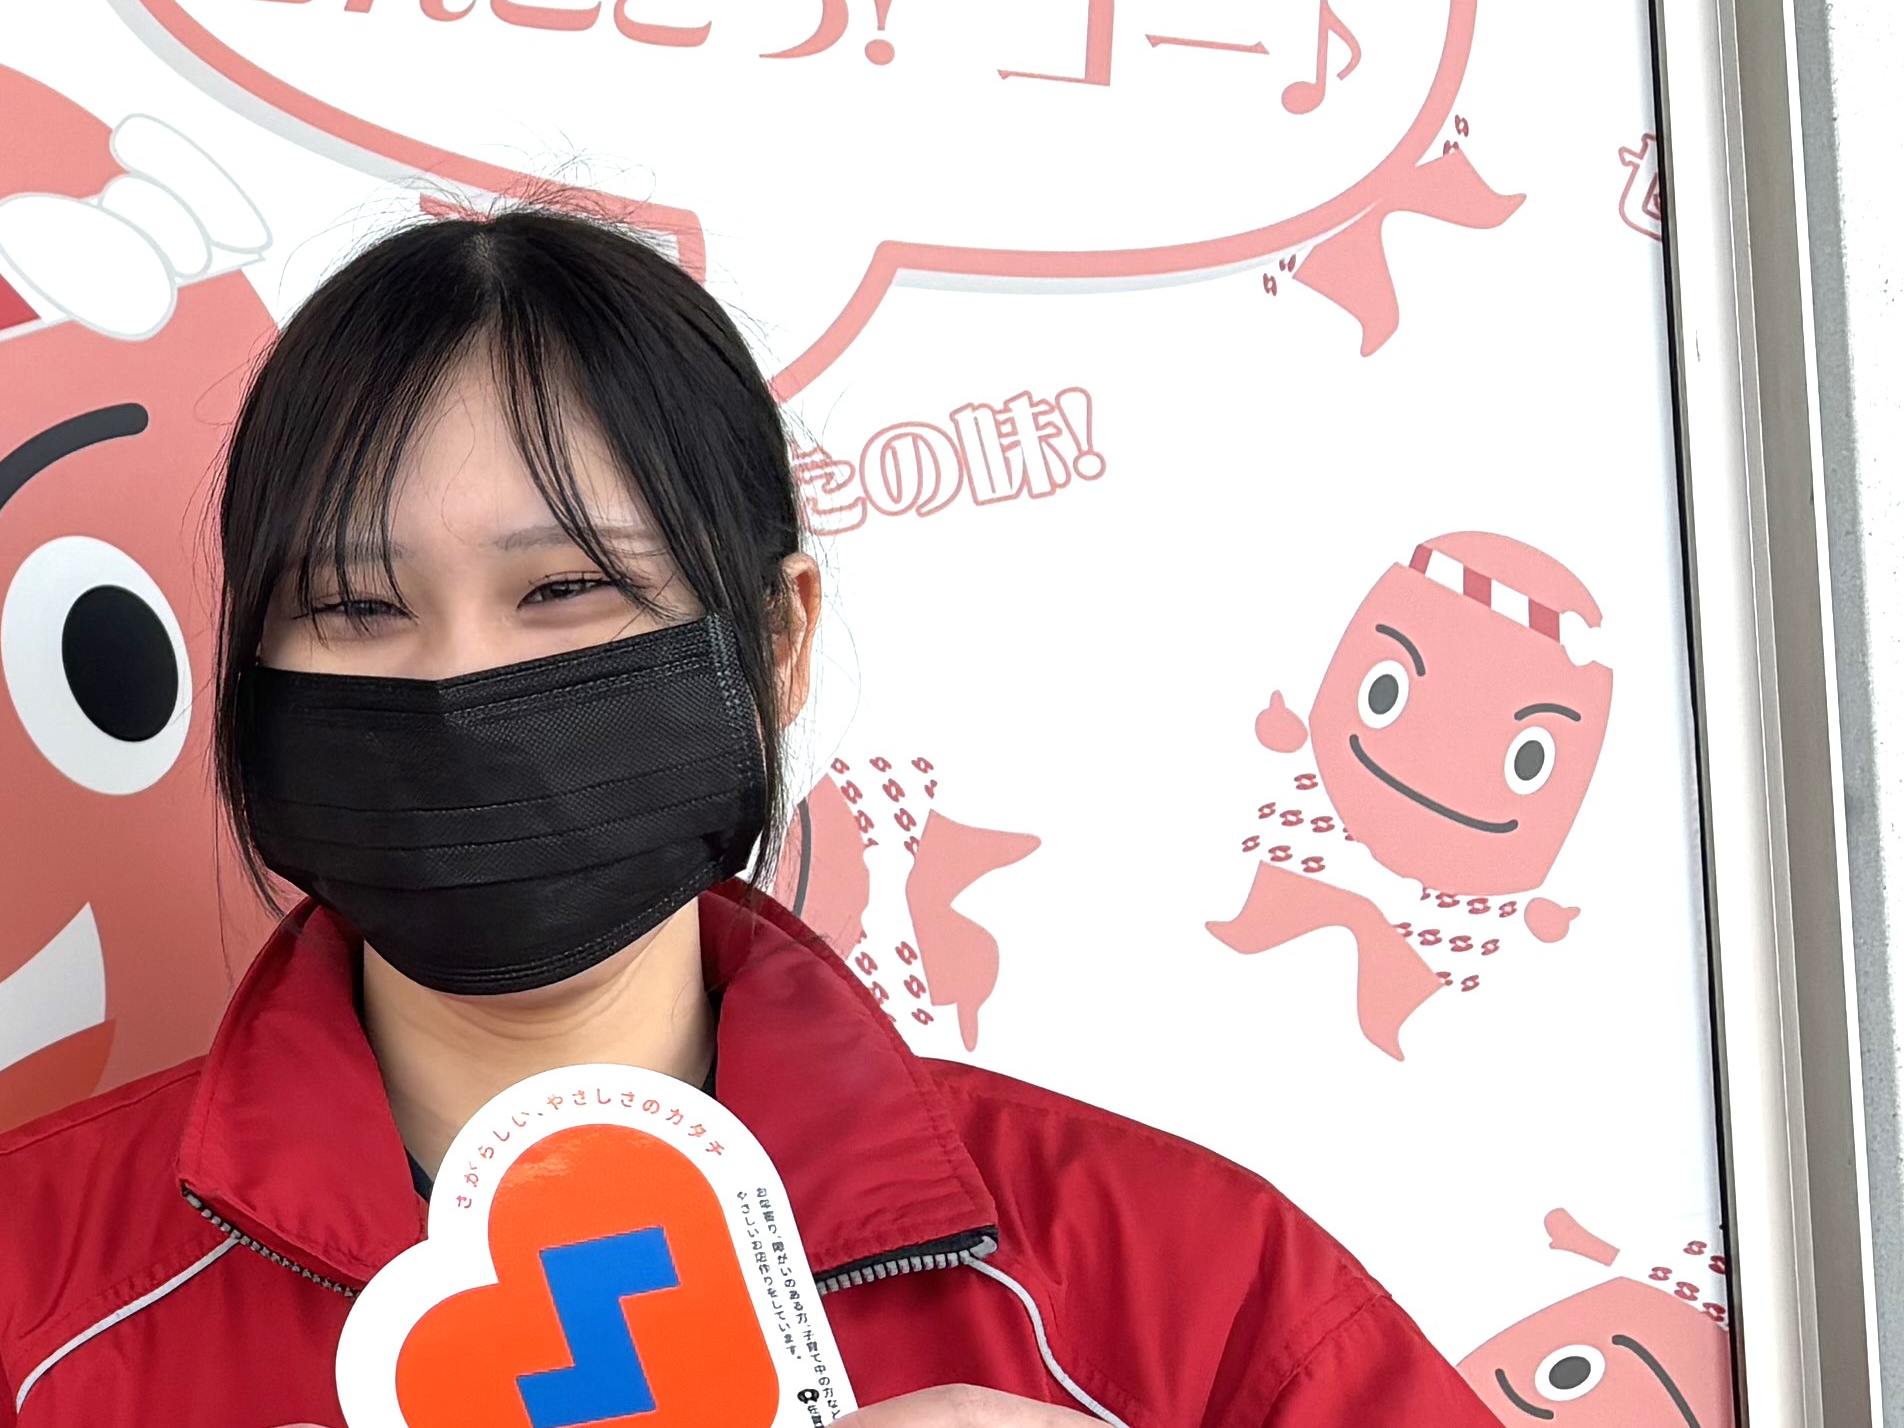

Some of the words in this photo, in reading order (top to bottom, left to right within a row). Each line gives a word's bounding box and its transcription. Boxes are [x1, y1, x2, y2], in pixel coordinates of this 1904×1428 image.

[456, 1088, 726, 1210] さがらしい、やさしさのカタチ
